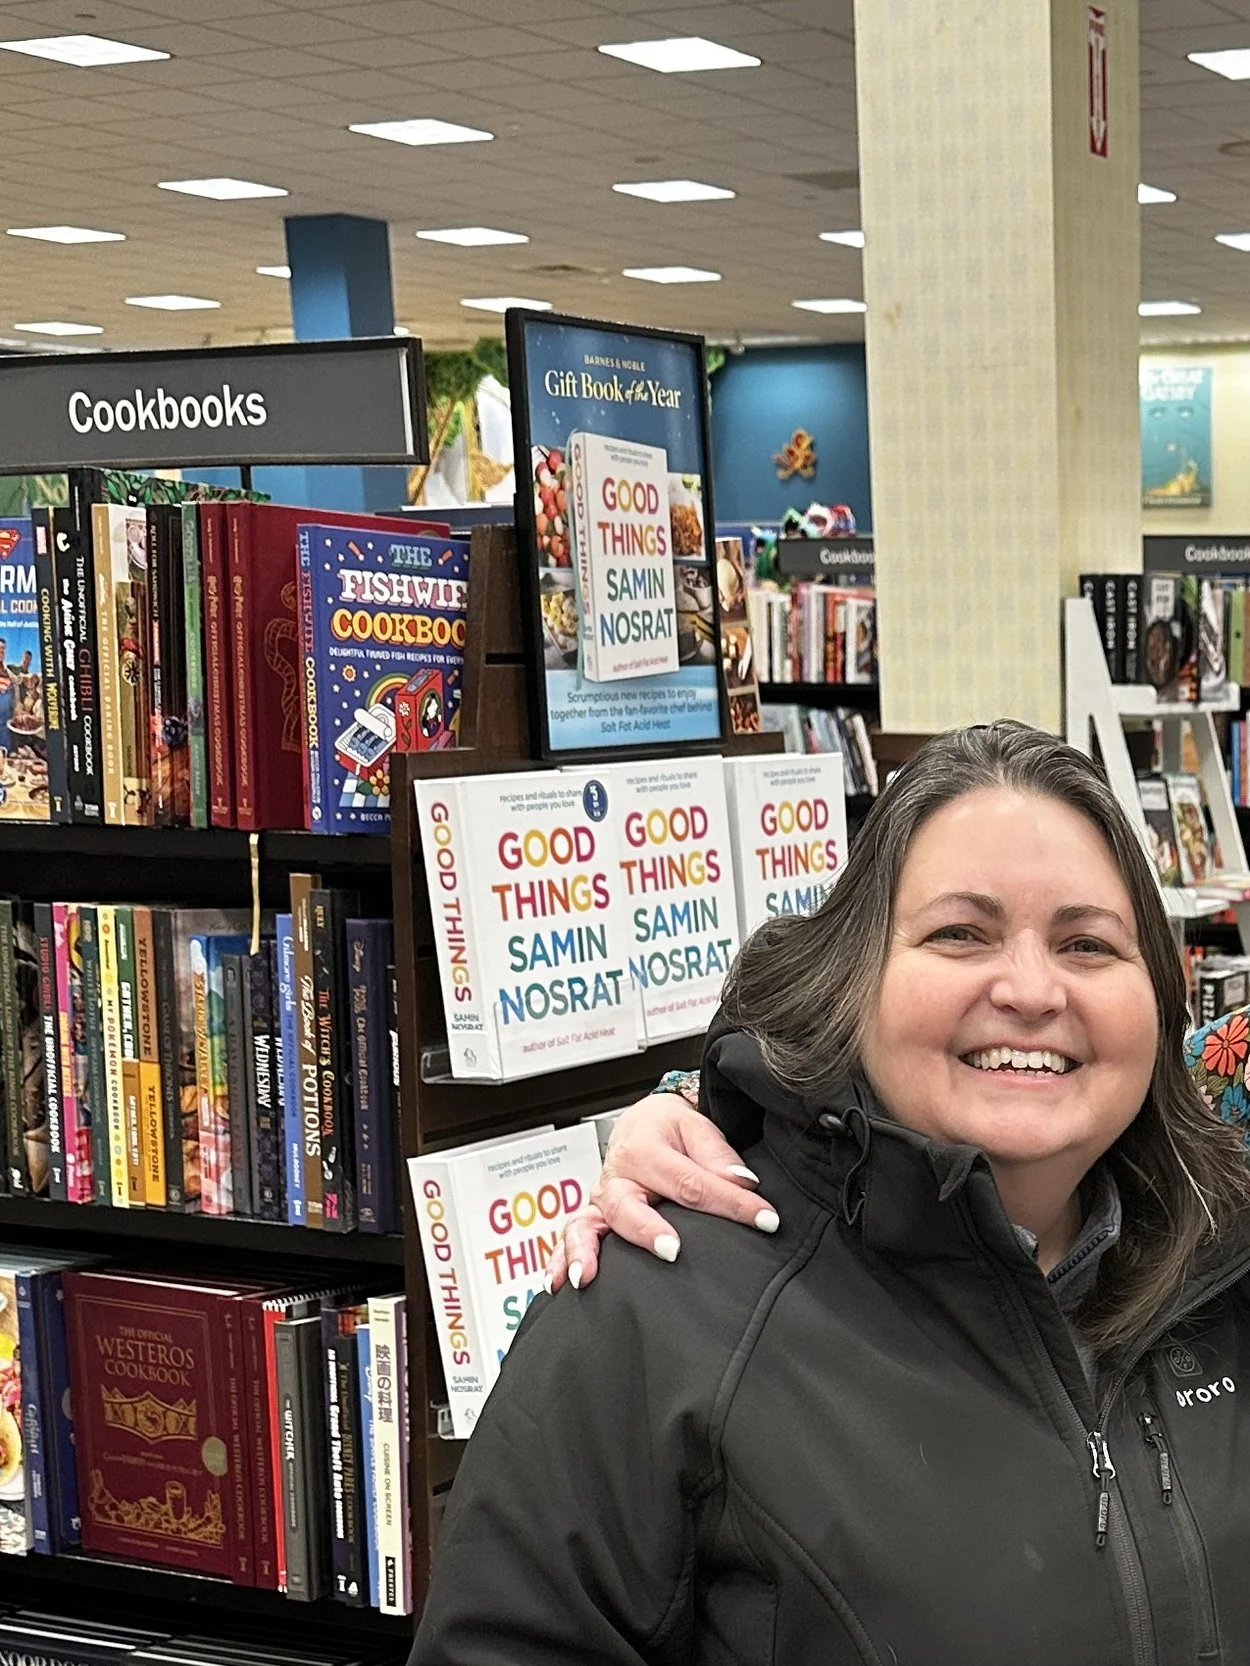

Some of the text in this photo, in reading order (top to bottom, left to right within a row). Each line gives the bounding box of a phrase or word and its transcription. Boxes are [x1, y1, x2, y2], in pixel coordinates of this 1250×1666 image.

[584, 354, 614, 368] BARNES
[621, 360, 646, 372] NOBLE
[69, 384, 267, 433] Cookbooks
[544, 370, 578, 397] Gift
[581, 372, 624, 403] Book
[647, 380, 682, 409] Year
[602, 477, 659, 515] GOOD
[389, 544, 433, 569] THE
[597, 522, 667, 557] THINGS
[338, 569, 468, 610] FISHWIF
[606, 568, 665, 602] SAMIN
[41, 588, 53, 643] COOKING
[331, 608, 467, 649] COOKBOO
[600, 608, 673, 647] NOSRAT
[44, 645, 55, 678] WITH
[79, 648, 94, 711] GHIBLI
[305, 656, 319, 751] COOKBOOK
[625, 805, 709, 848] GOOD
[761, 798, 829, 836] GOOD
[498, 826, 596, 870] GOOD
[755, 838, 838, 881] THINGS
[619, 849, 721, 896] THINGS
[430, 801, 472, 1003] GOOD THINGS
[492, 873, 611, 923] THINGS
[633, 896, 719, 943] SAMIN
[507, 924, 608, 973] SAMIN
[628, 938, 733, 991] NOSRAT
[138, 937, 151, 1057] YELLOWSTONE
[300, 975, 314, 1000] The
[499, 969, 623, 1025] NOSRAT
[43, 1015, 54, 1035] THE
[301, 999, 316, 1039] Book
[254, 1034, 272, 1108] WEDNESDAY
[302, 1064, 321, 1157] POTIONS
[147, 1085, 160, 1183] YELLOWSTONE
[488, 1178, 583, 1236] GOOD
[423, 1179, 471, 1366] GOOD THINGS
[95, 1334, 196, 1370] WESTEROS
[104, 1358, 192, 1388] COOKBOOK
[1175, 1376, 1236, 1408] ororo
[383, 1443, 393, 1526] CUISINE ON SCREEN
